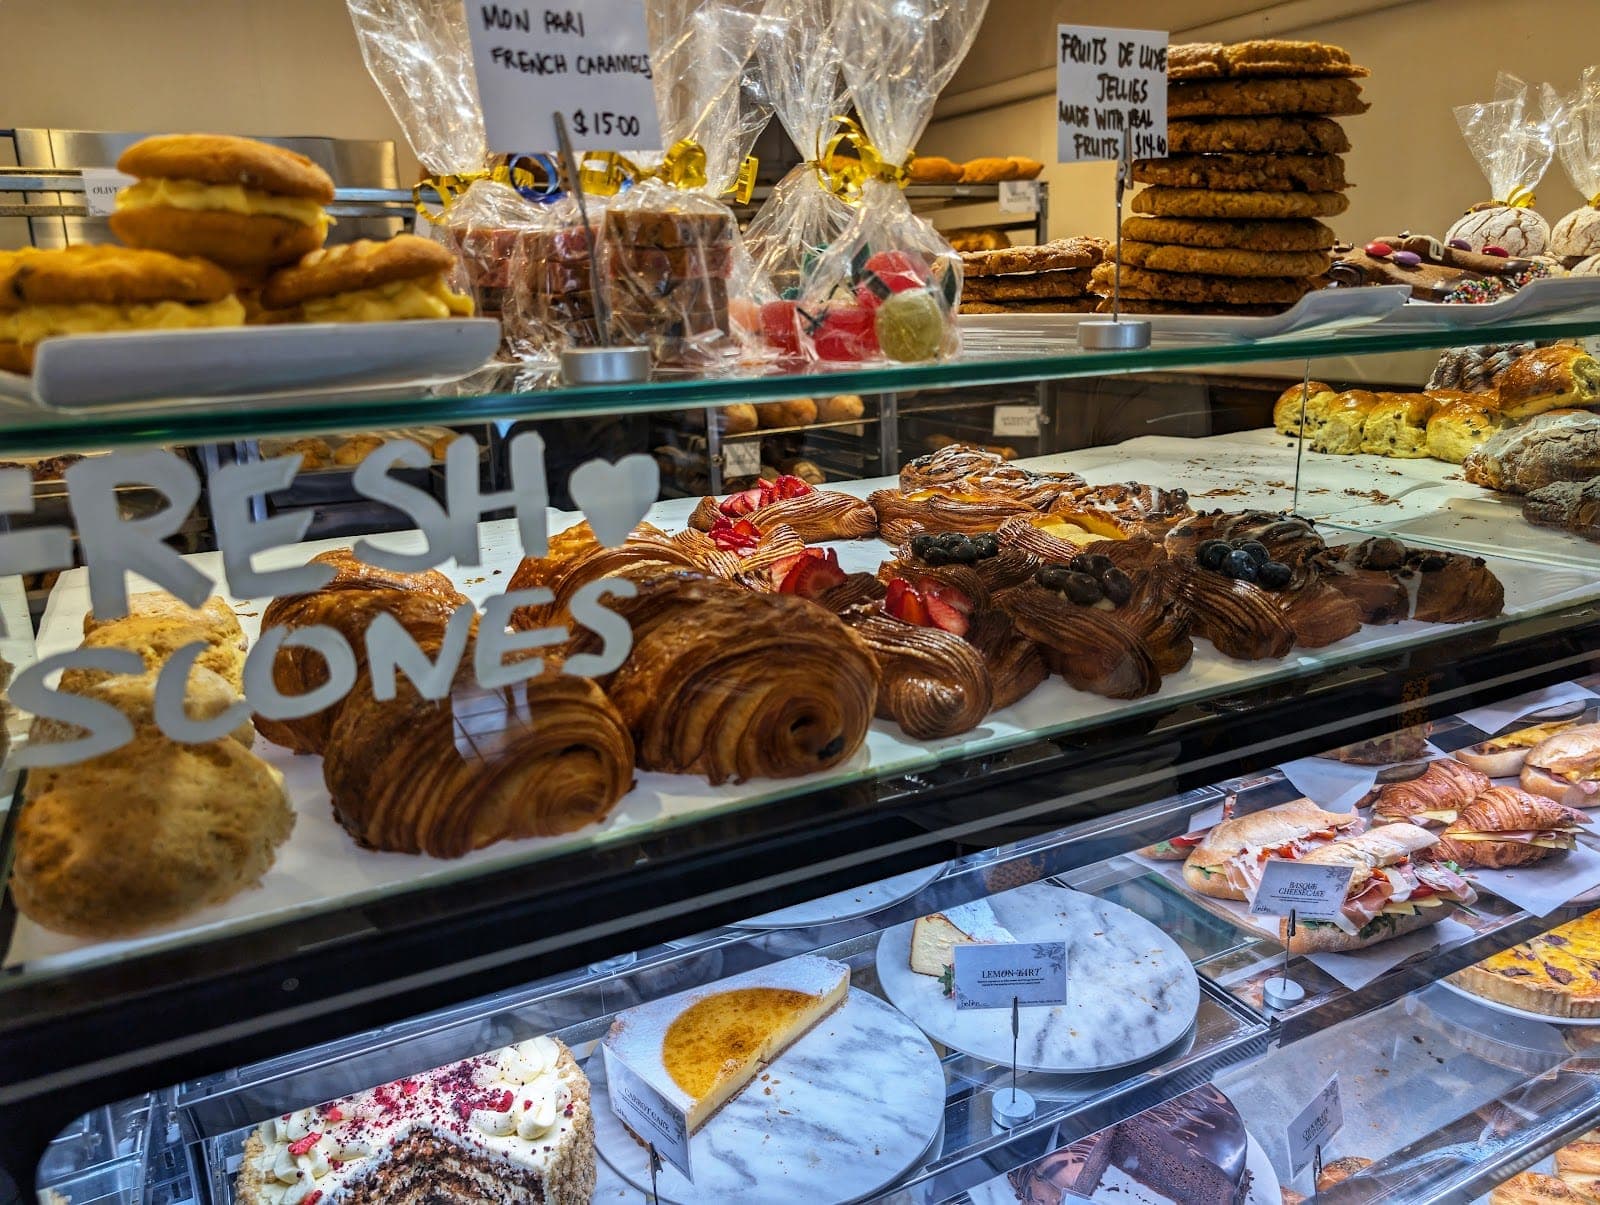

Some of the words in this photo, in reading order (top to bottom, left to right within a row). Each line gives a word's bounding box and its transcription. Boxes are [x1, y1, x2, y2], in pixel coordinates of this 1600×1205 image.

[481, 6, 530, 33] MON
[544, 11, 585, 37] PARI
[491, 48, 568, 75] FRENCH
[576, 54, 653, 79] CARAMELS
[1061, 33, 1107, 65] FRUITS
[1118, 42, 1135, 68] DE
[1139, 45, 1167, 72] LUXE
[1096, 72, 1148, 104] JELLIES
[1058, 100, 1089, 128] MADE
[1094, 108, 1124, 132] WITH
[1127, 108, 1154, 129] REAL
[1073, 133, 1119, 160] FRUITS
[8, 577, 639, 770] SCONES
[1278, 887, 1325, 897] CHEESECAKE
[1289, 881, 1318, 891] BASQUE
